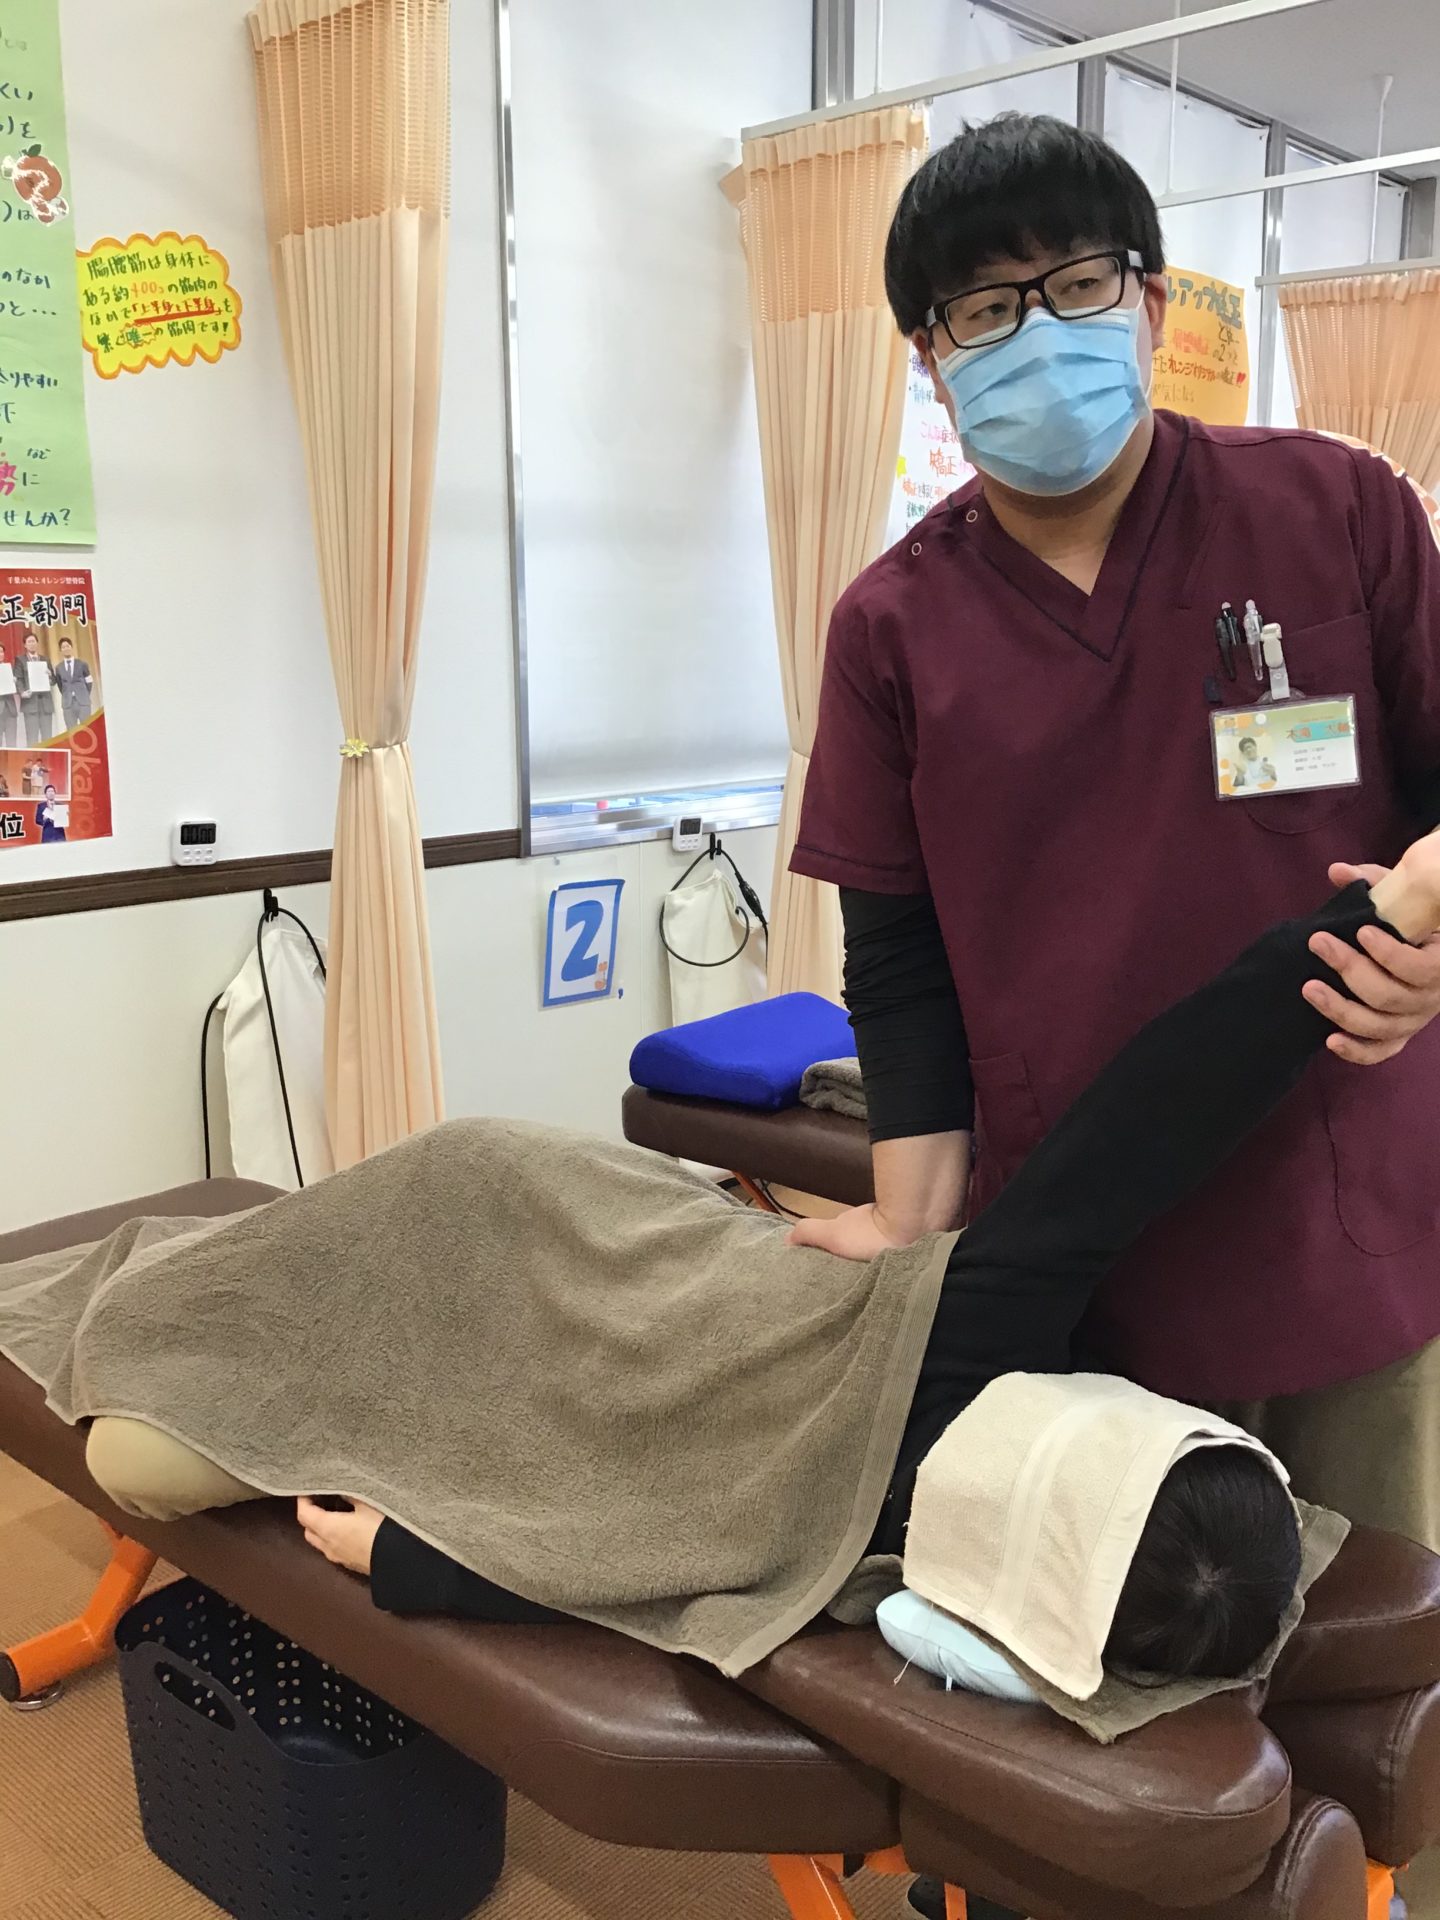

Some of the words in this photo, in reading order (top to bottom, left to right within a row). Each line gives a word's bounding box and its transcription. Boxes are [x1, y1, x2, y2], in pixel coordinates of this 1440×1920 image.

[4, 508, 71, 527] せんか?
[0, 594, 88, 627] 正部門
[69, 725, 102, 832] Okano
[561, 899, 604, 983] 2
